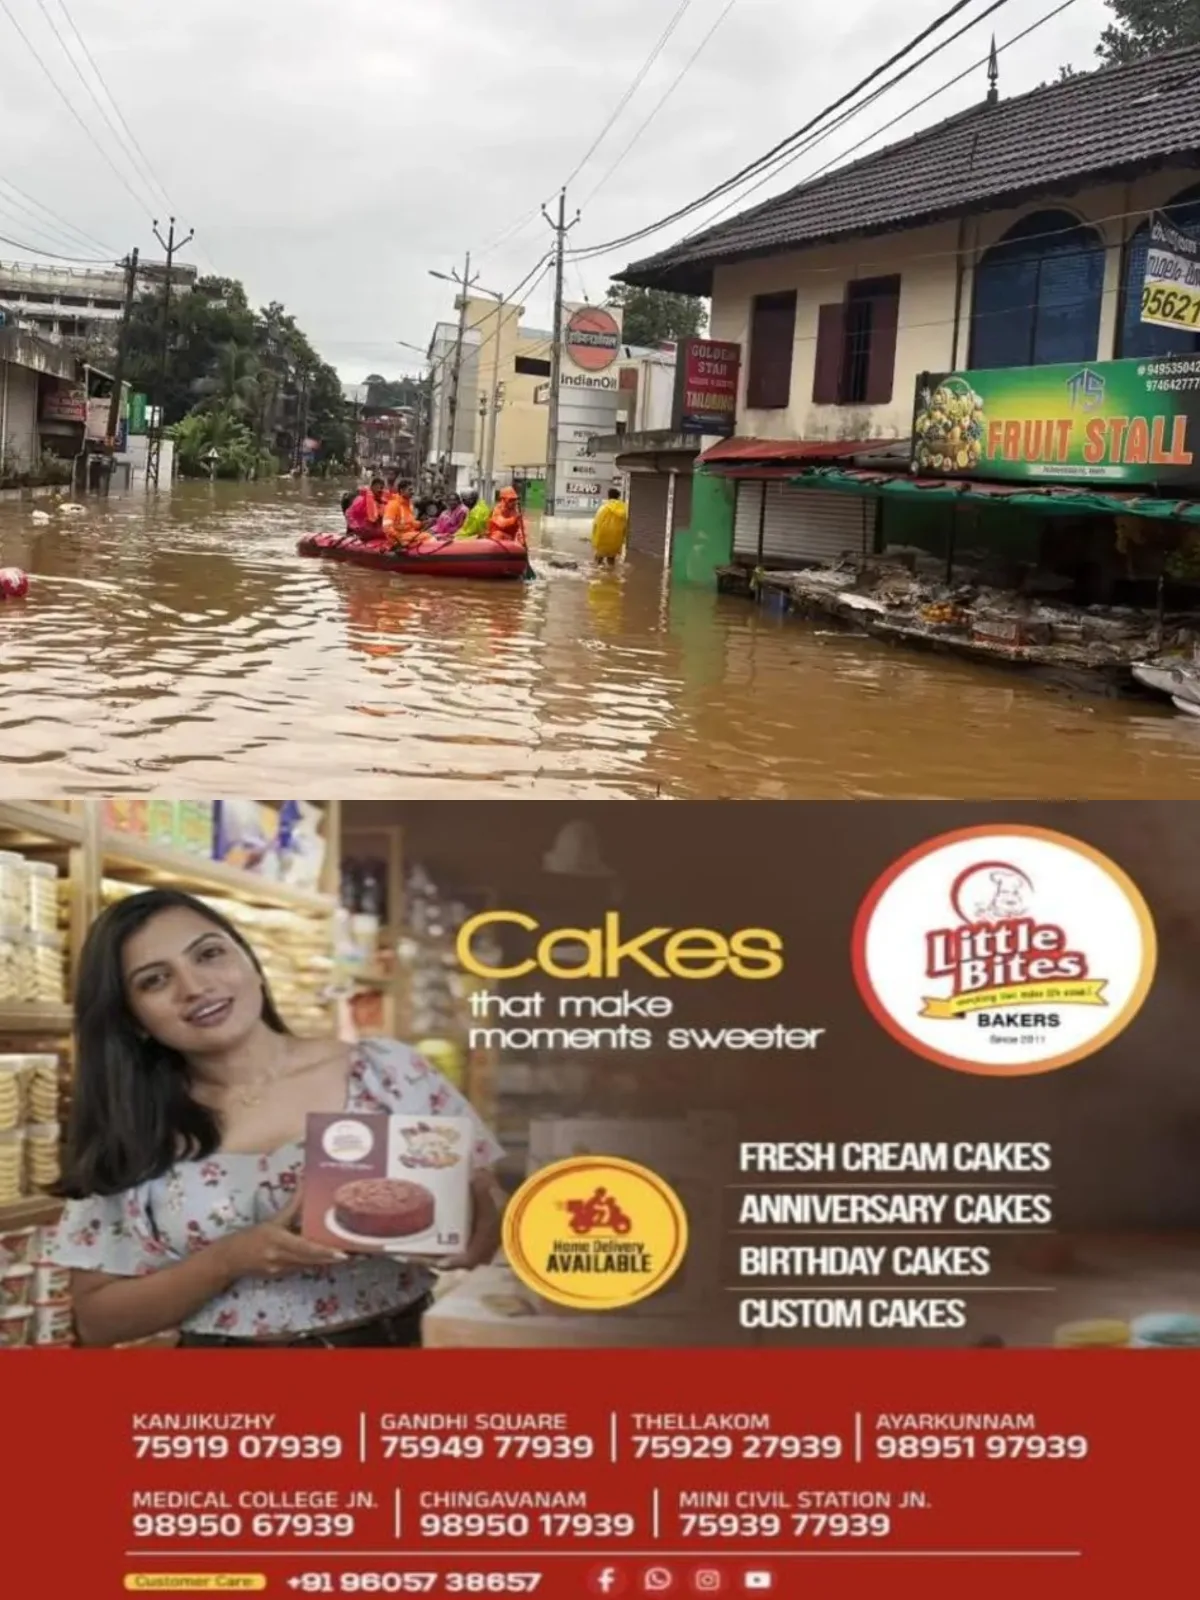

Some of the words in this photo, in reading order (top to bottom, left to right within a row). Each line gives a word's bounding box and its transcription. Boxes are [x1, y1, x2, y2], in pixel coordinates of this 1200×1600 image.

[560, 374, 618, 389] IndianOil
[985, 418, 1073, 464] FRUIT
[1082, 414, 1193, 465] STALL
[456, 910, 784, 980] Cakes
[927, 919, 1066, 978] Little
[953, 951, 1088, 995] Bites
[469, 989, 545, 1018] that
[559, 989, 673, 1018] make
[977, 1013, 1061, 1028] BAKERS
[468, 1023, 652, 1050] moments
[668, 1023, 825, 1050] sweeter
[740, 1142, 835, 1171] FRESH
[842, 1142, 948, 1171] CREAM
[953, 1142, 1051, 1171] CAKES
[739, 1194, 948, 1223] ANNIVERSARY
[955, 1194, 1052, 1223] CAKES
[553, 1240, 590, 1253] Home
[593, 1239, 645, 1255] Delivery
[546, 1254, 651, 1273] AVAILABLE
[740, 1246, 886, 1275] BIRTHDAY
[893, 1246, 990, 1275] CAKES
[740, 1299, 862, 1328] CUSTOM
[868, 1299, 966, 1328] CAKES
[133, 1413, 275, 1431] KANJIKUZHY
[381, 1413, 468, 1430] GANDHI
[475, 1413, 567, 1431] SQUARE
[632, 1413, 769, 1430] THELLAKOM
[876, 1413, 1035, 1430] AYARKUNNAM
[133, 1435, 229, 1459] 75919
[239, 1435, 342, 1459] 07939
[381, 1435, 484, 1459] 75949
[494, 1435, 594, 1459] 77939
[632, 1435, 733, 1459] 75929
[742, 1435, 842, 1459] 27939
[876, 1435, 975, 1459] 98951
[985, 1435, 1088, 1459] 97939
[133, 1491, 231, 1508] MEDICAL
[239, 1491, 338, 1508] COLLEGE
[347, 1491, 378, 1508] JN.
[420, 1491, 586, 1508] CHINGAVANAM
[679, 1491, 729, 1508] MINI
[736, 1491, 790, 1508] CIVIL
[797, 1491, 891, 1508] STATION
[899, 1491, 931, 1508] JN.
[132, 1513, 242, 1537] 98950
[252, 1513, 354, 1537] 67939
[420, 1513, 529, 1537] 98950
[539, 1513, 635, 1537] 17939
[679, 1513, 781, 1537] 75939
[791, 1513, 891, 1537] 77939
[135, 1575, 208, 1587] Customer
[215, 1575, 253, 1587] Care
[287, 1573, 334, 1592] +91
[340, 1572, 438, 1593] 96057
[445, 1572, 542, 1593] 38657
